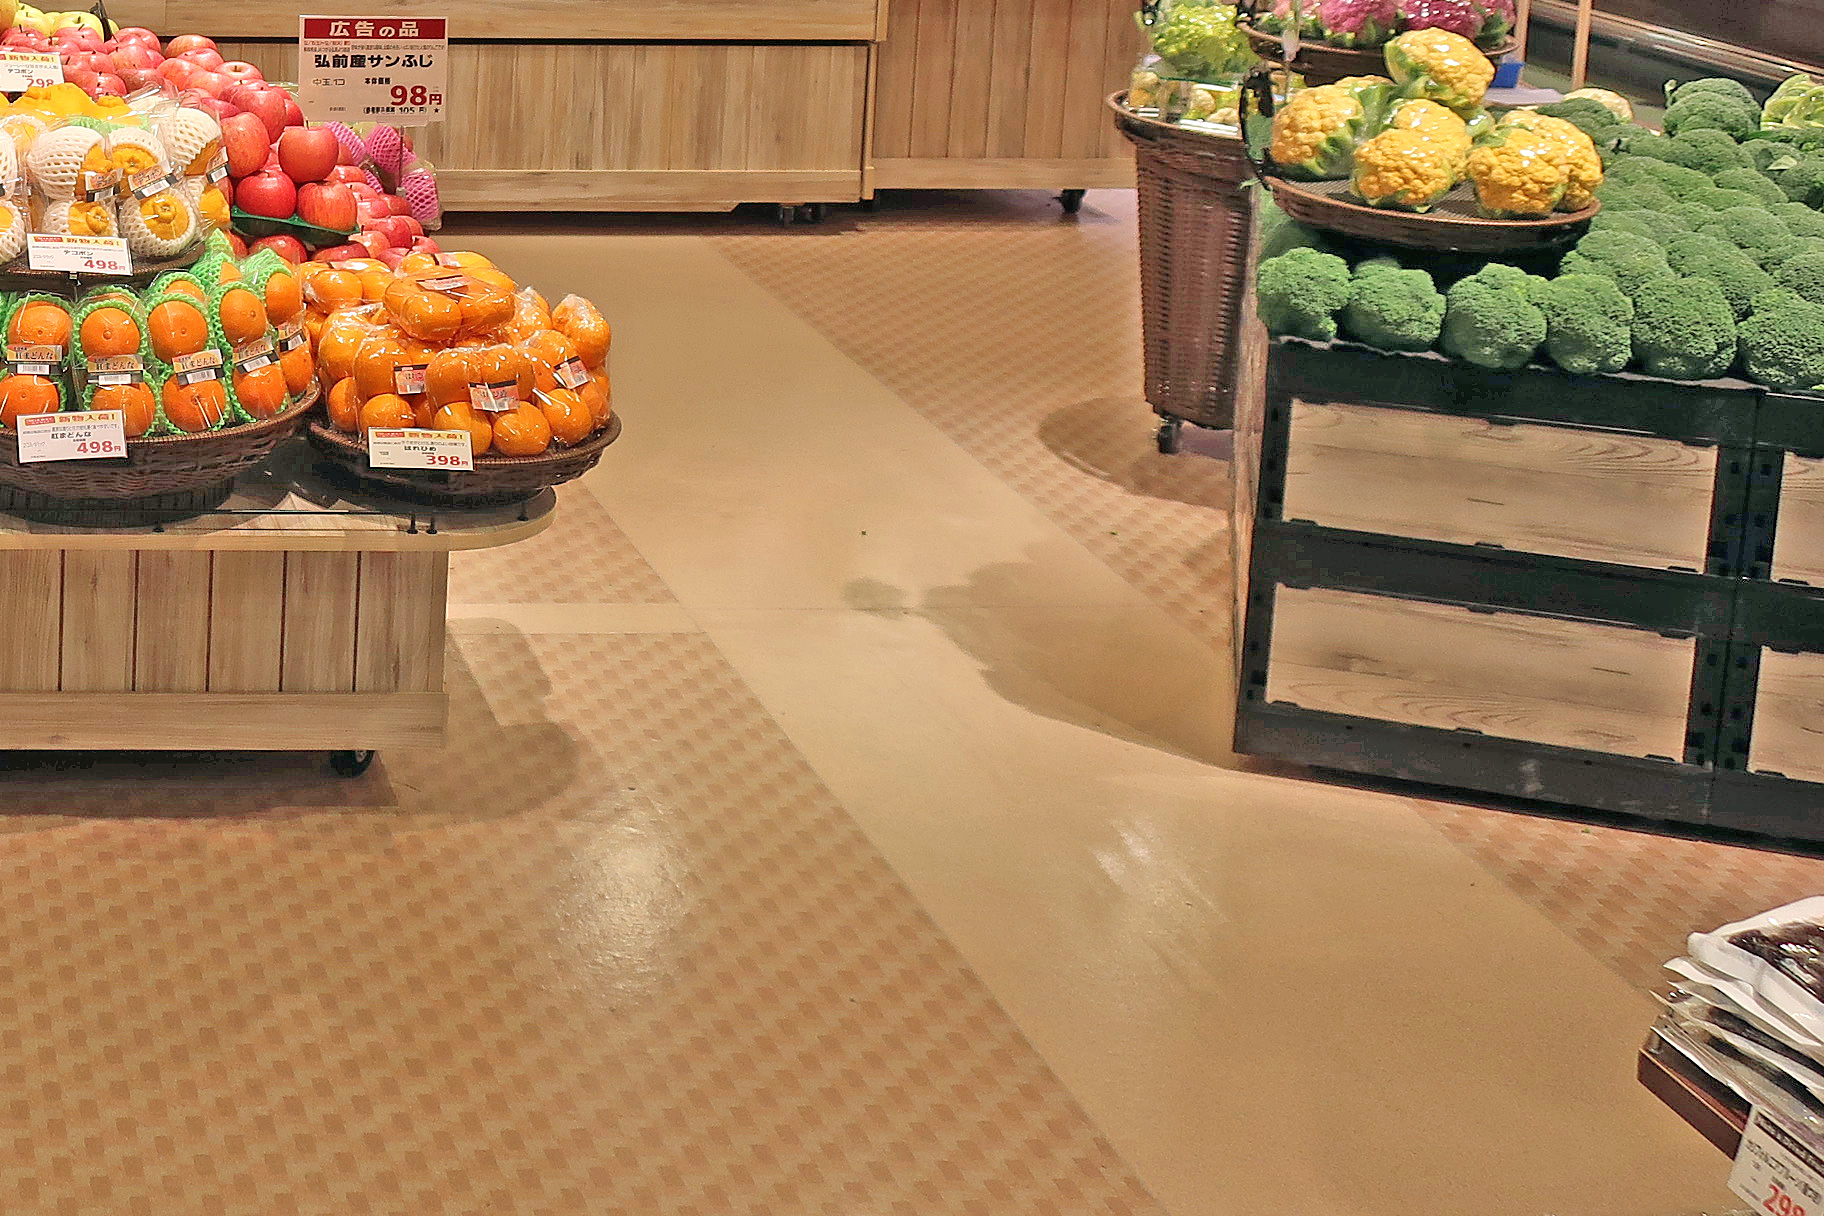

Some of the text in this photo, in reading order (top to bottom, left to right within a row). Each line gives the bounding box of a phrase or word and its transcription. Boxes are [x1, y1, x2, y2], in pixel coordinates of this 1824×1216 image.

[329, 20, 419, 37] 広告の品
[314, 54, 433, 68] 弘前産サンふじ
[390, 85, 442, 106] 98円
[83, 259, 126, 270] 498円
[15, 350, 54, 361] 紅まどんな
[95, 360, 135, 371] 紅まどんな
[76, 440, 121, 453] 498円
[426, 455, 468, 466] 398円
